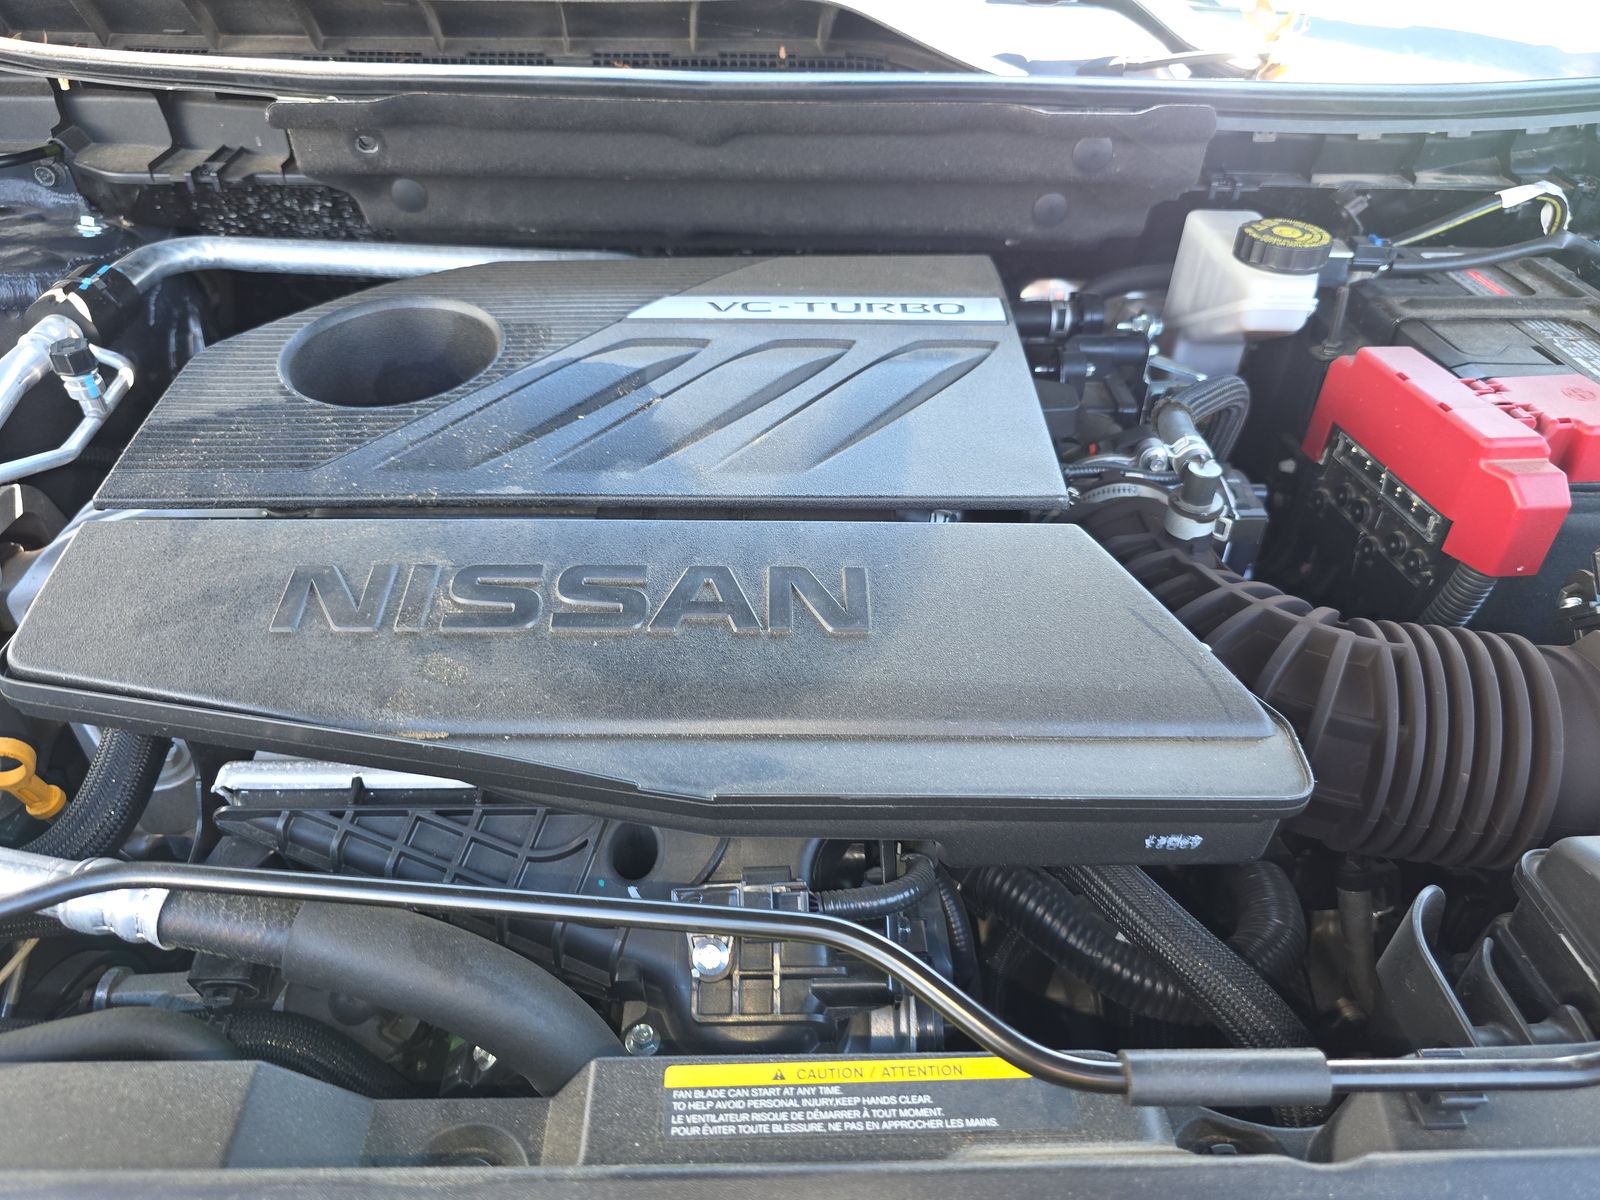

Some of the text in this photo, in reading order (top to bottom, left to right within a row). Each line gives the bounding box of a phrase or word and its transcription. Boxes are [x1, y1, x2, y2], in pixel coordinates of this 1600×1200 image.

[707, 300, 966, 315] VC-TURBO
[269, 563, 872, 634] NISSAN
[796, 1067, 864, 1080] CAUTION
[882, 1064, 964, 1078] ATTENTION
[672, 1085, 844, 1099] FAN BLADE CAN START AT ANY TIME.
[672, 1101, 687, 1111] TO
[687, 1100, 715, 1110] HELP
[715, 1099, 746, 1109] AVOID
[747, 1098, 801, 1109] PERSONAL
[862, 1095, 898, 1105] HANDS
[898, 1094, 934, 1104] CLEAR.
[671, 1106, 946, 1124] LE VENTILATEUR RISQUE DE DÉMARRER À TOUT MOMENT.
[670, 1125, 701, 1136] POUR
[701, 1122, 737, 1136] ÉVITER
[737, 1123, 771, 1135] TOUTE
[827, 1121, 843, 1132] NE
[843, 1121, 865, 1132] PAS
[865, 1120, 881, 1131] EN
[881, 1118, 944, 1131] APPROCHER
[945, 1118, 965, 1129] LES
[965, 1117, 1000, 1128] MAINS.
